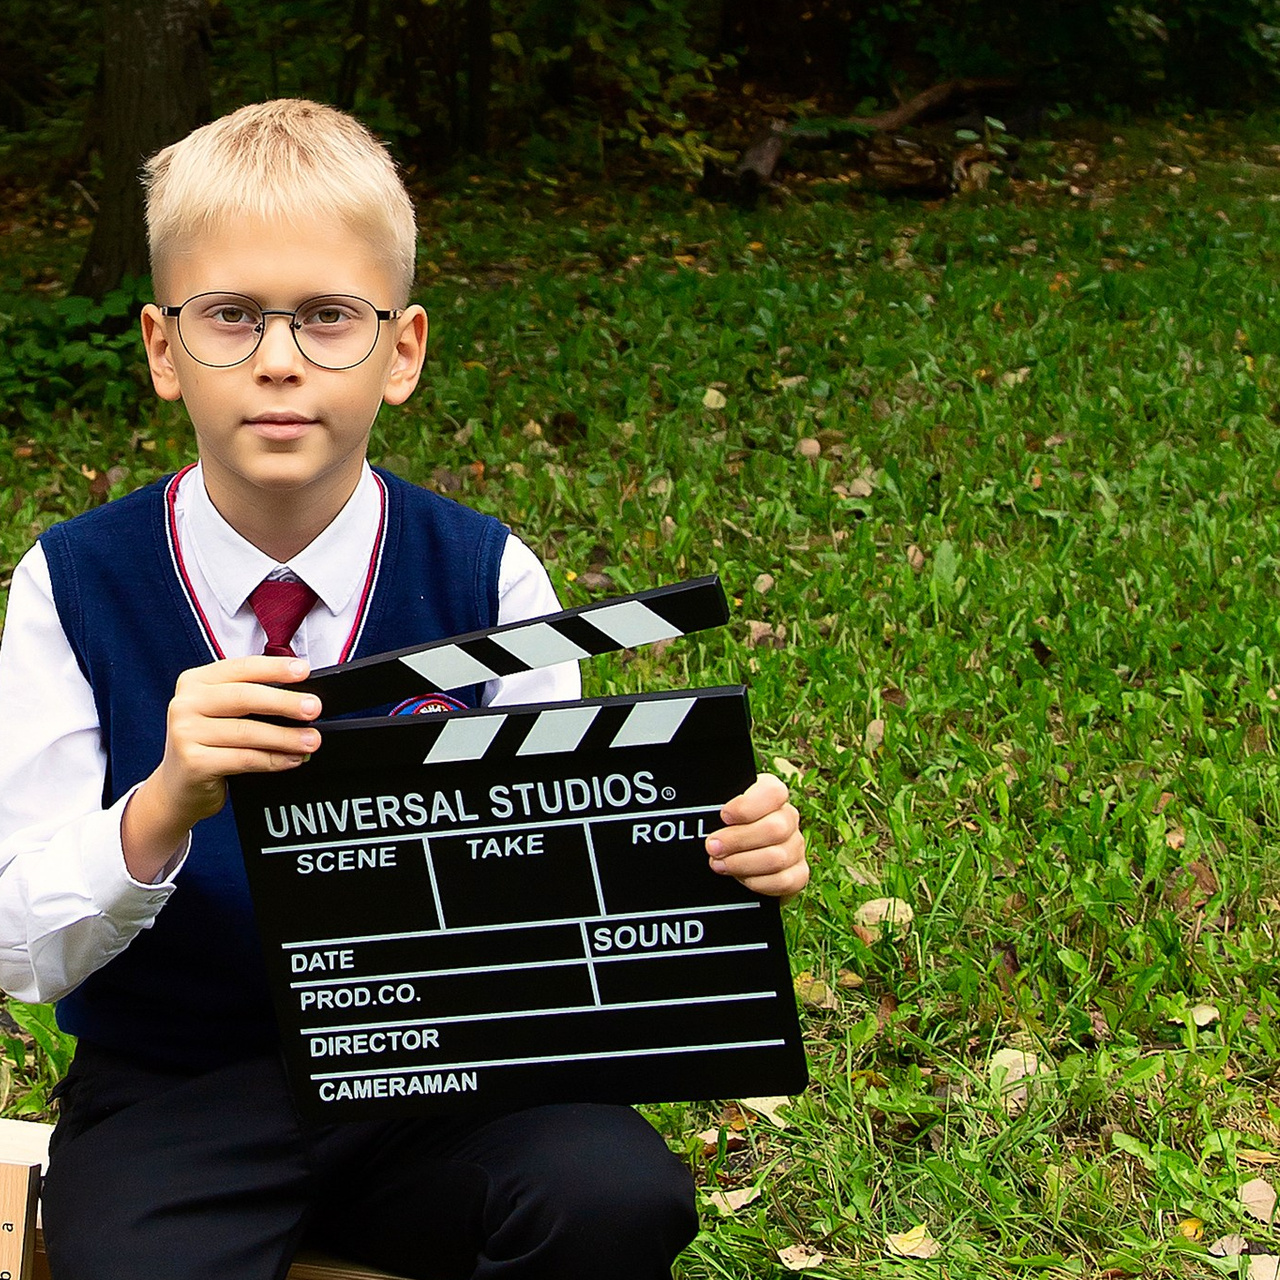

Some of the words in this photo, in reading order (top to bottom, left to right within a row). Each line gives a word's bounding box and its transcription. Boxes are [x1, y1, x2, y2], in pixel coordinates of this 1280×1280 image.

[263, 789, 479, 839] UNIVERSAL
[631, 818, 712, 845] ROLL
[296, 846, 398, 875] SCENE
[466, 833, 545, 860] TAKE
[593, 919, 705, 952] SOUND
[290, 949, 355, 974] DATE
[300, 983, 422, 1011] PROD.CO.
[310, 1028, 440, 1058] DIRECTOR
[318, 1071, 479, 1102] CAMERAMAN
[2, 1222, 14, 1232] a
